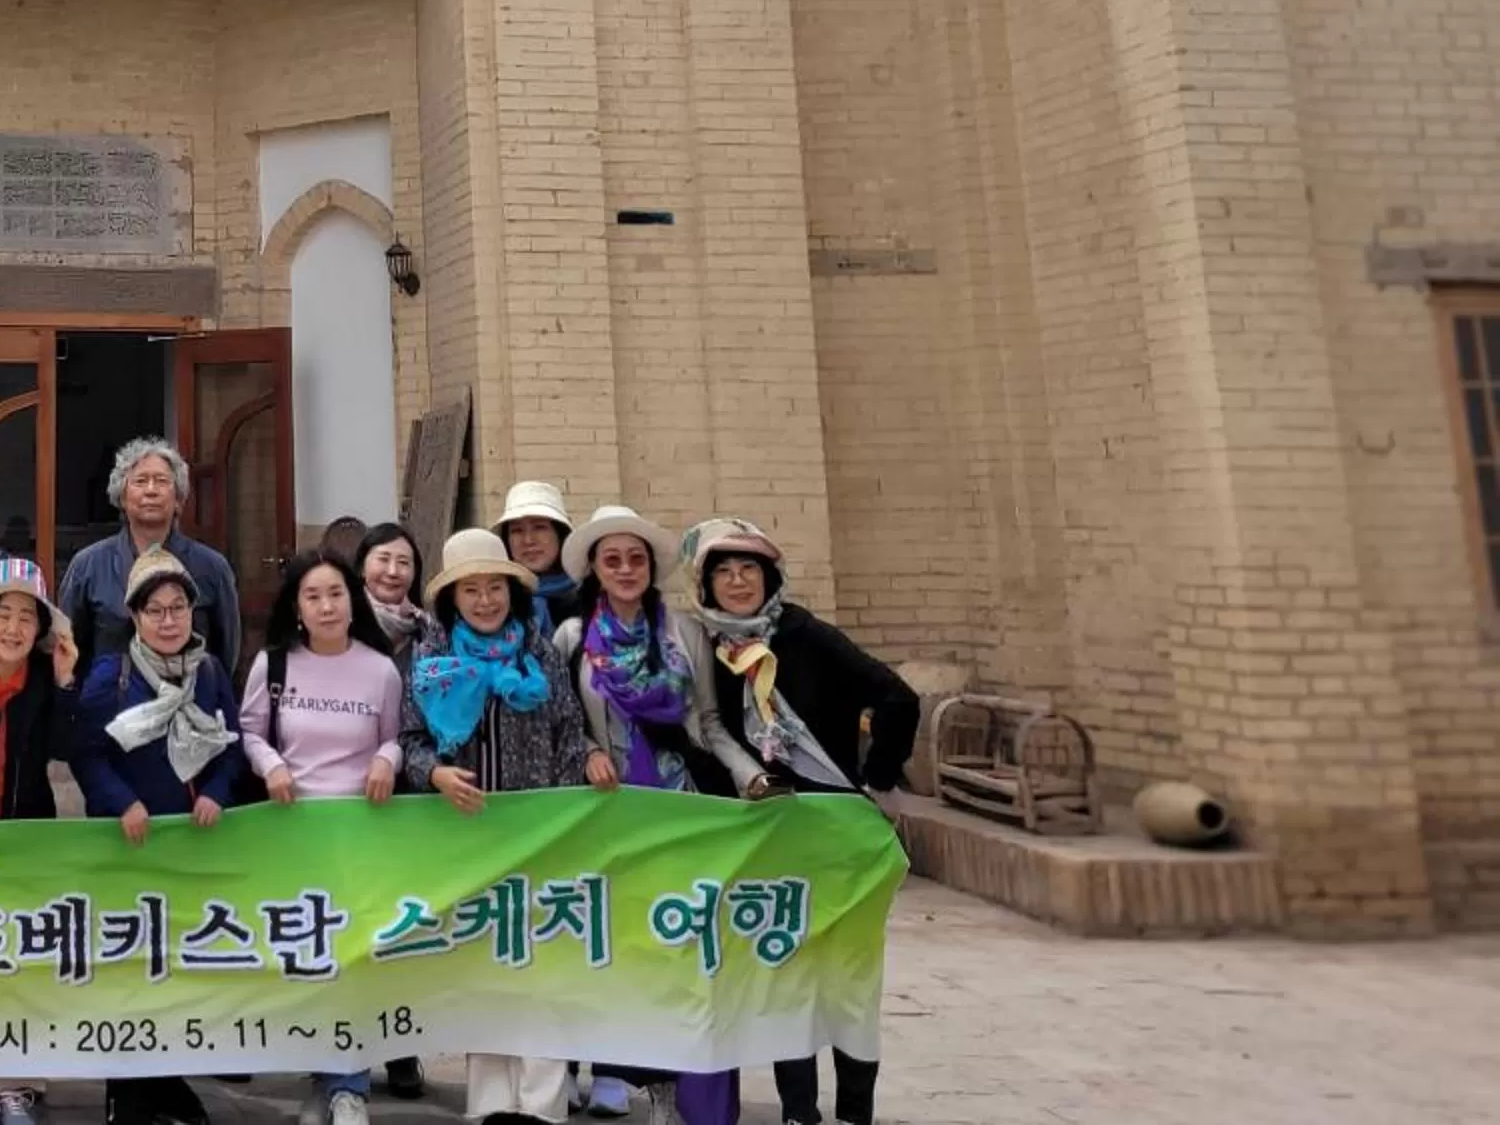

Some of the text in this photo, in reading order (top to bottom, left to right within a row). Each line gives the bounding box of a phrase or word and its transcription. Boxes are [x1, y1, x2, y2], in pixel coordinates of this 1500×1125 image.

[281, 696, 373, 716] PEARLYGATES
[373, 877, 607, 965] 스케치
[652, 880, 807, 971] 여행
[76, 1019, 169, 1052] 2023.
[185, 1018, 216, 1052] 5.
[233, 1018, 268, 1049] 11
[335, 1020, 364, 1051] 5.
[377, 1006, 424, 1040] 18.
